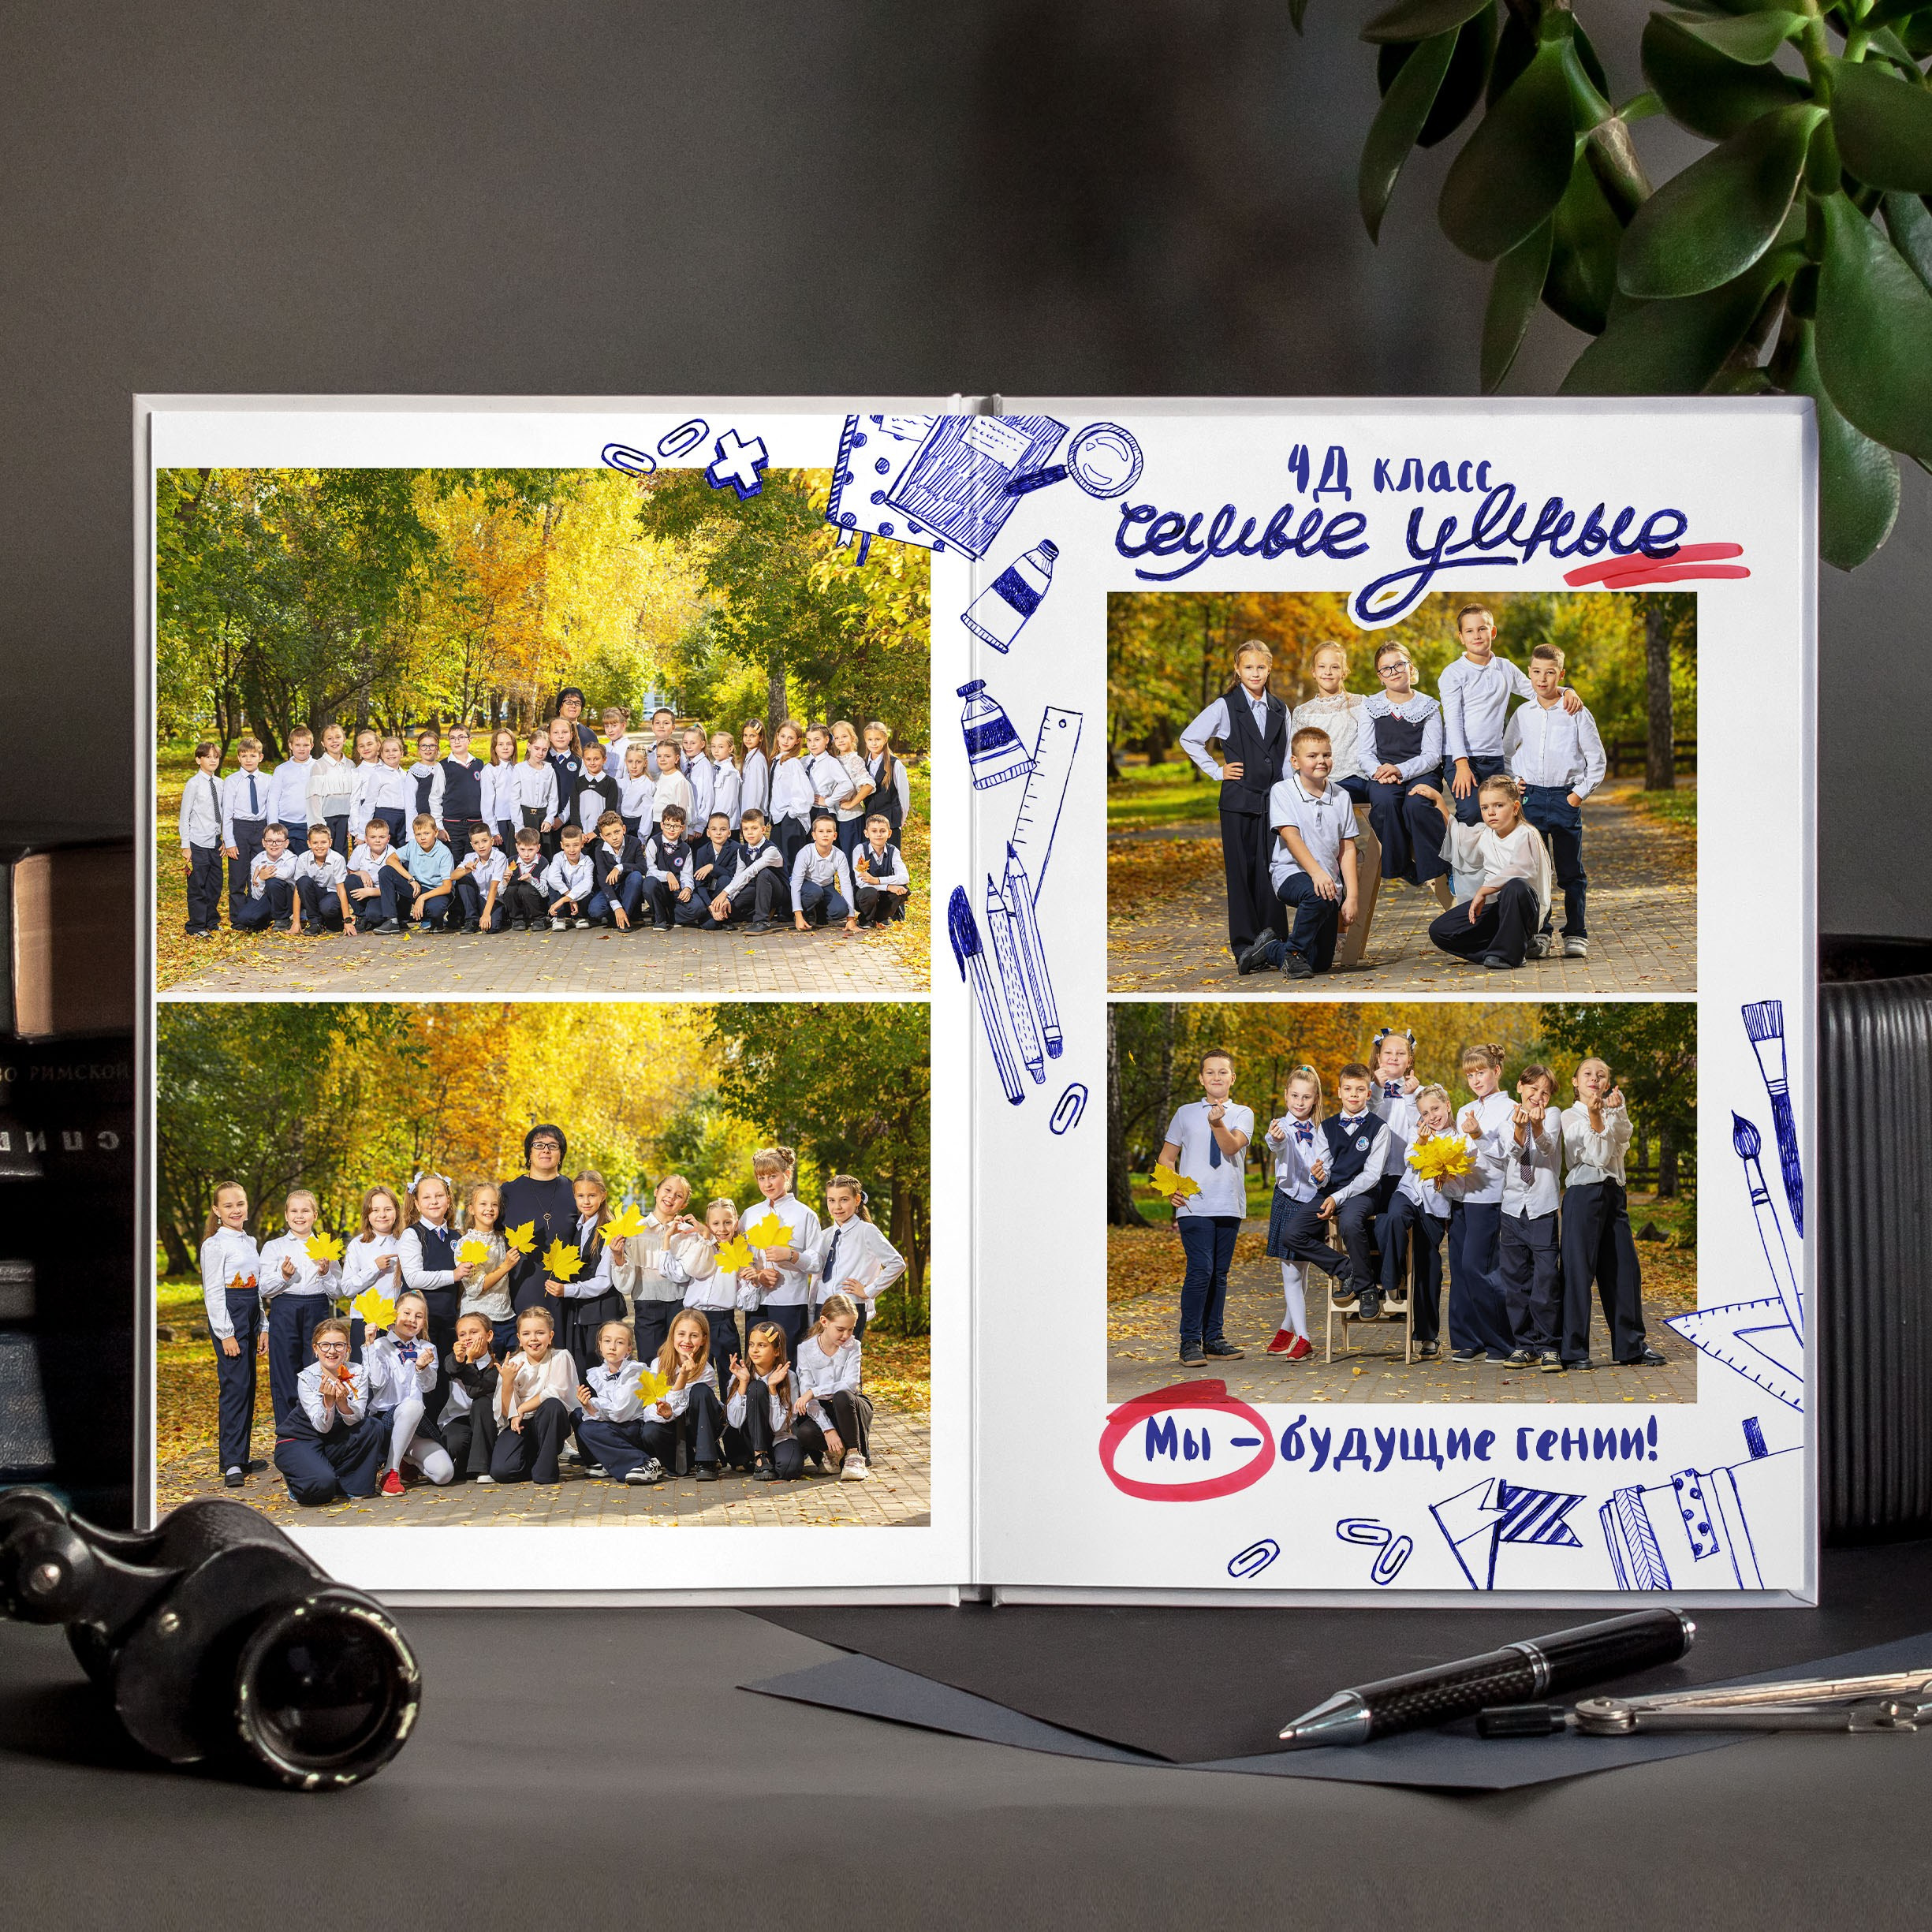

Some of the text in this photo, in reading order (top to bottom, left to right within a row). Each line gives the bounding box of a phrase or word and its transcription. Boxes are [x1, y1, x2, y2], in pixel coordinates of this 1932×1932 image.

[1287, 444, 1492, 502] 4Д класс
[1113, 482, 1688, 621] самые умные
[1146, 1416, 1210, 1461] Мы
[1281, 1414, 1496, 1472] будущие
[1516, 1415, 1658, 1461] гении!
